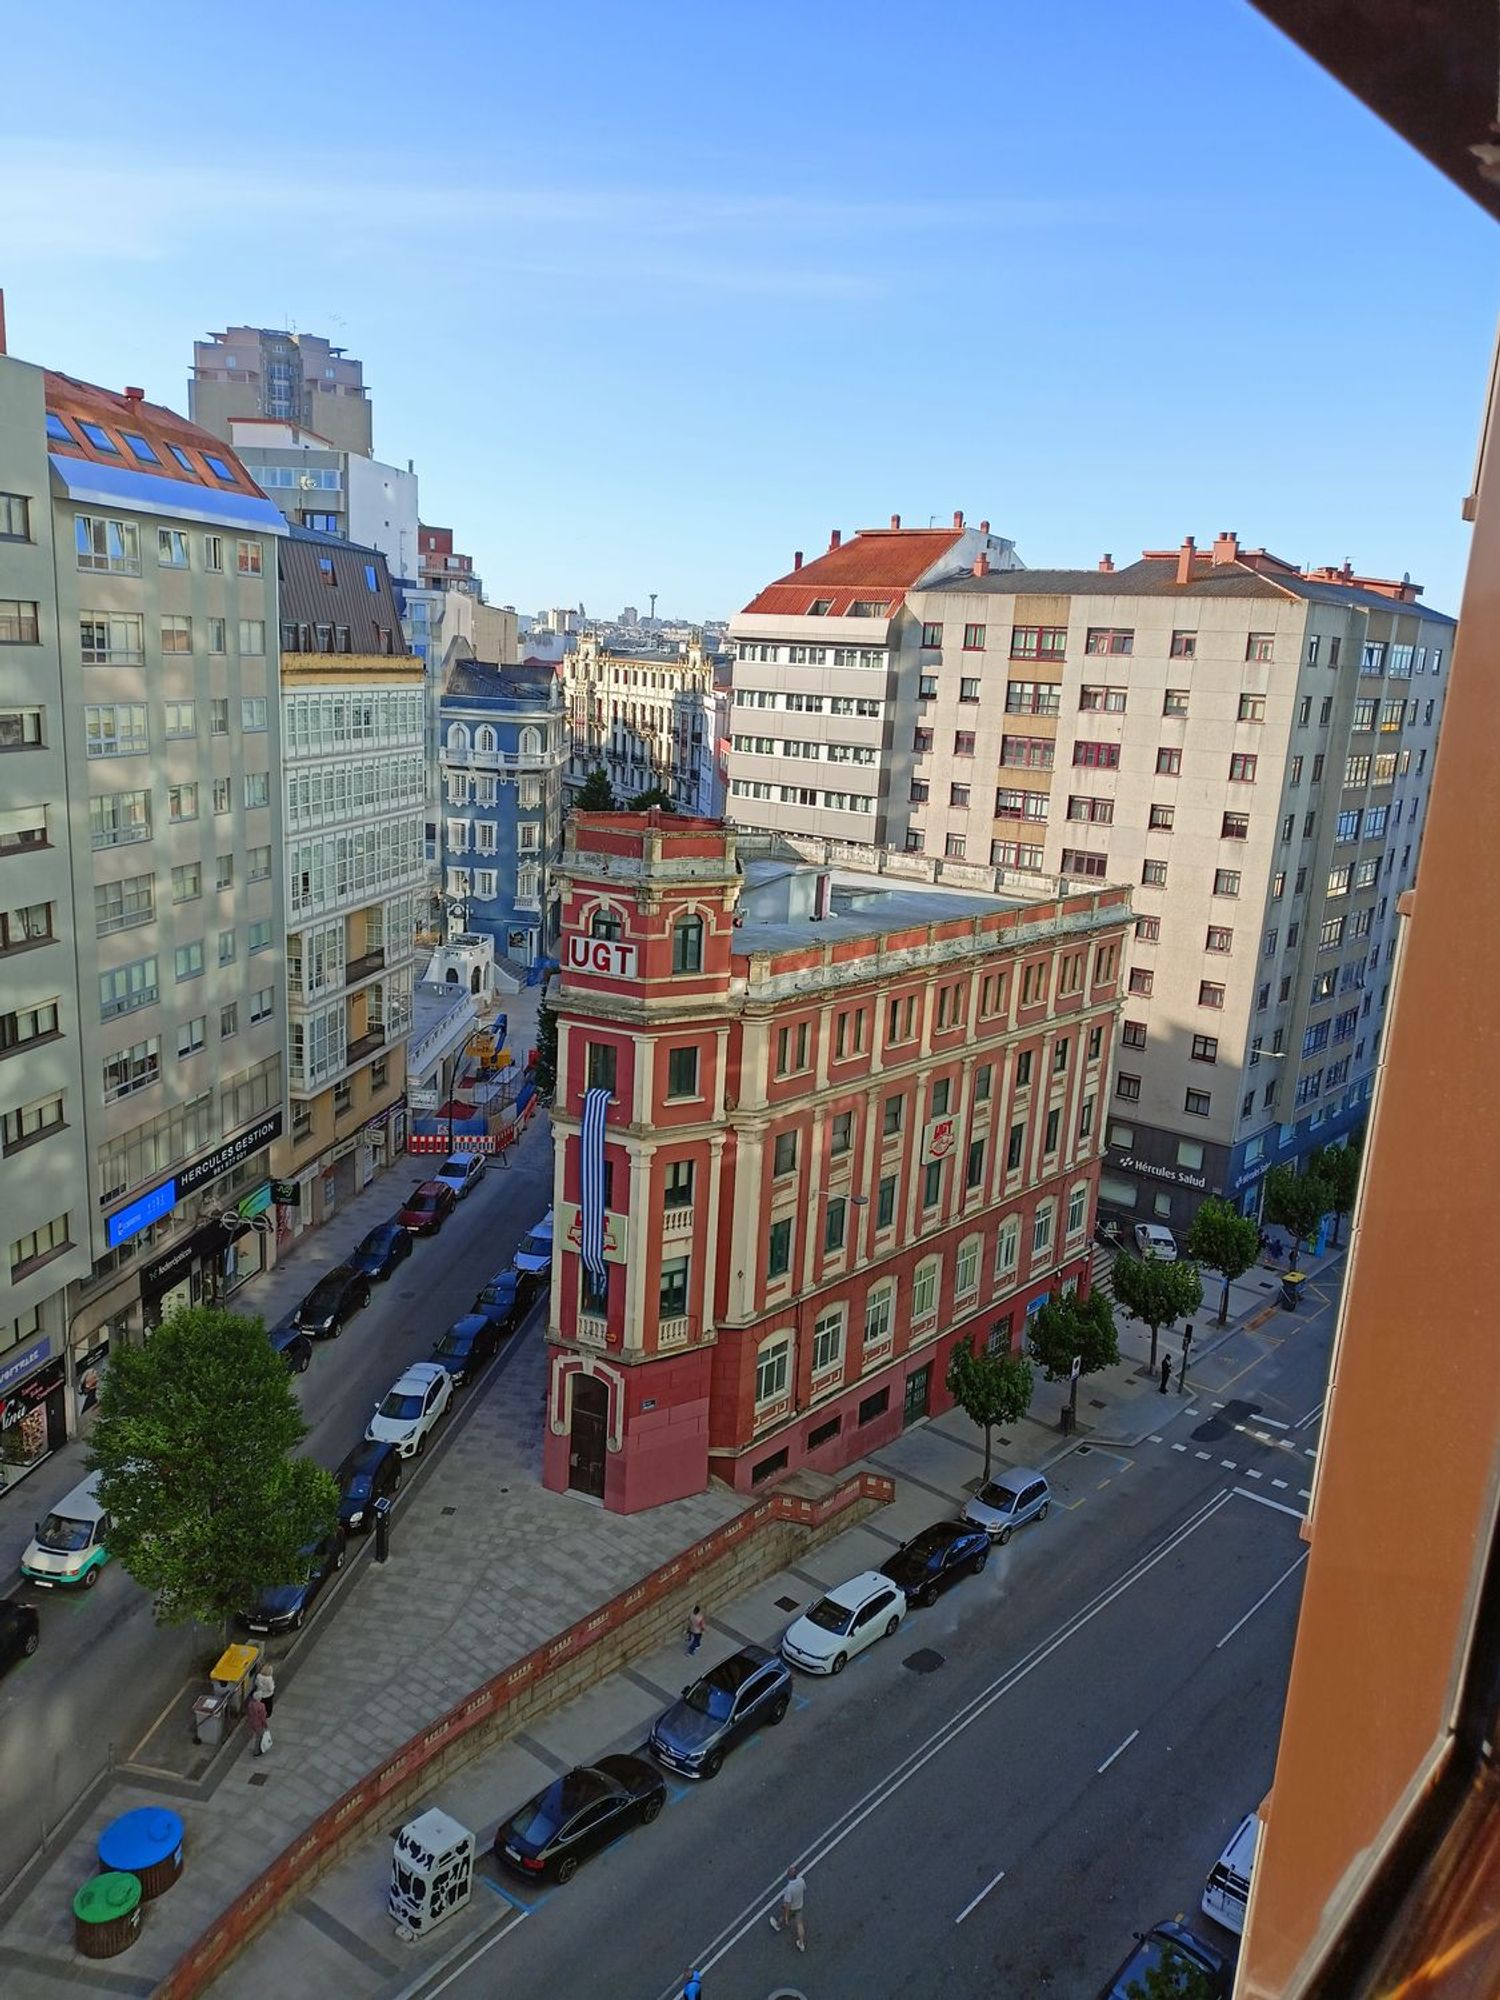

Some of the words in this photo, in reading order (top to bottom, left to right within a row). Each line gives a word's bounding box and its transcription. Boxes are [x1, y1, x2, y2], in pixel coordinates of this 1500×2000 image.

[570, 938, 634, 975] UGT
[180, 1146, 234, 1187] HERCULES
[234, 1121, 275, 1152] GESTION
[1134, 1159, 1177, 1181] Hércules
[1177, 1171, 1207, 1189] Salud
